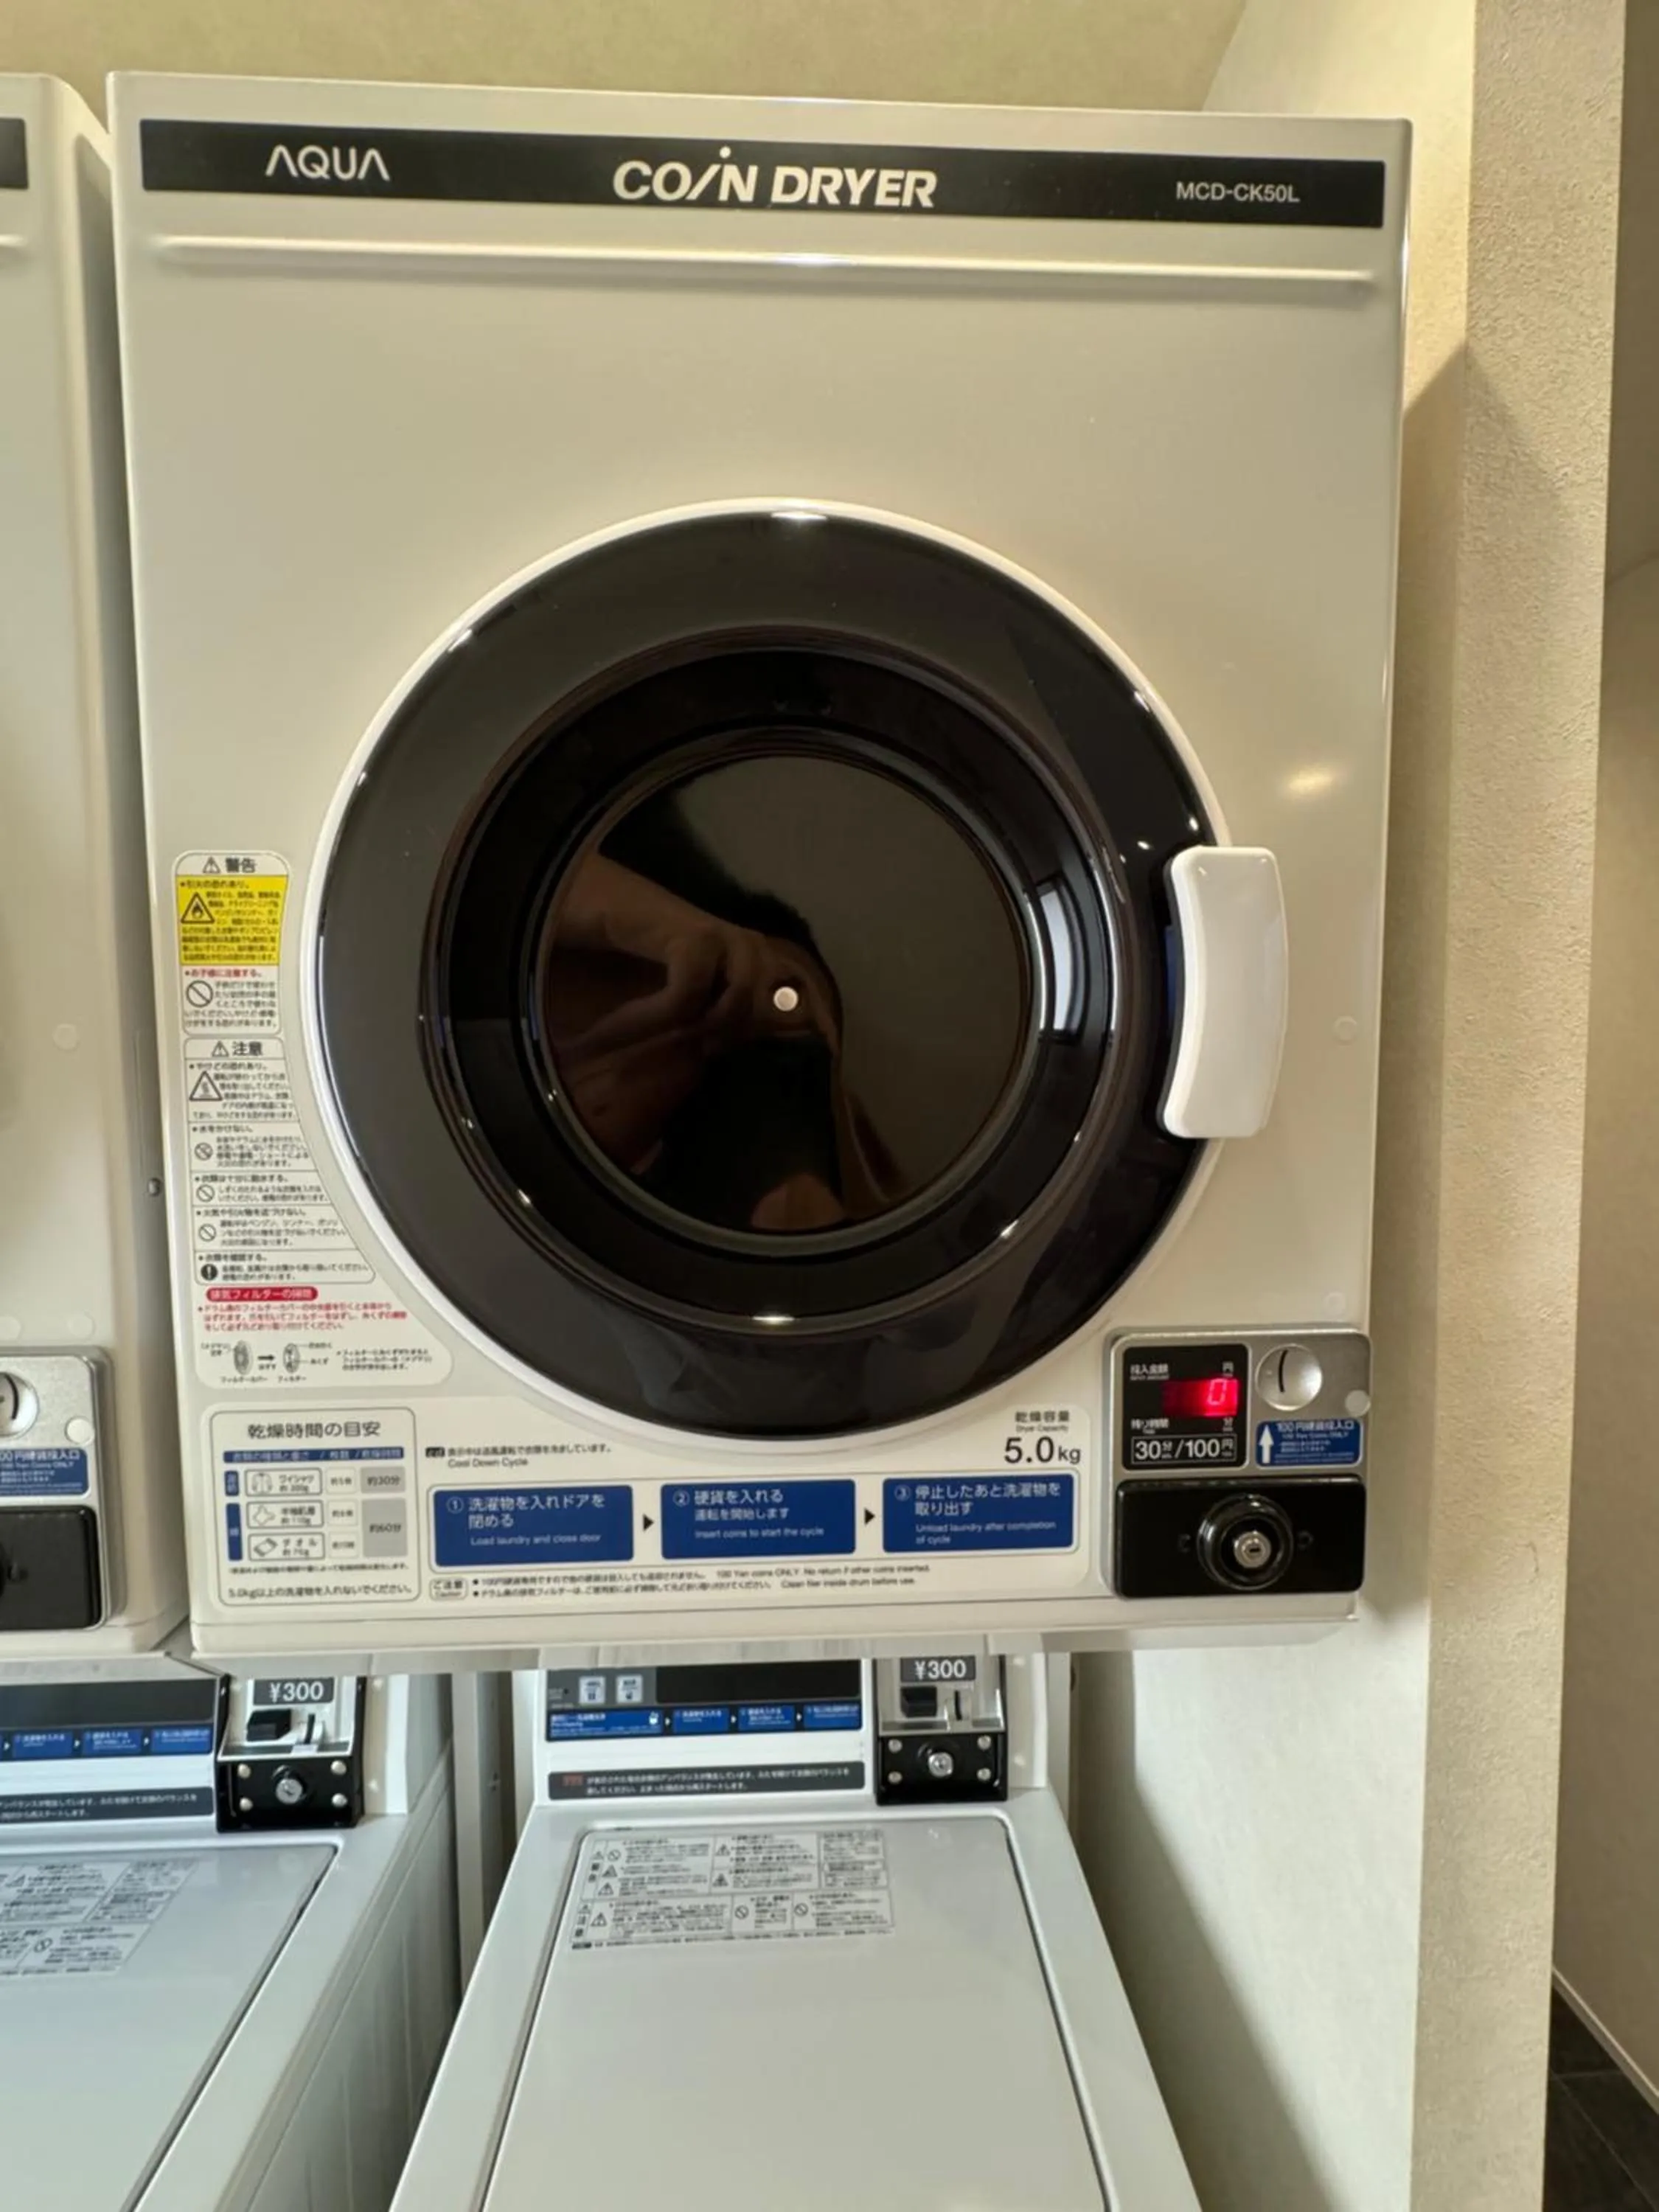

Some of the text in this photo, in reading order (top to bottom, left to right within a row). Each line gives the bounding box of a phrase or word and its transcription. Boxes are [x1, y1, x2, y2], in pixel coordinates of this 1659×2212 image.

[265, 144, 391, 182] AQUA
[771, 165, 938, 208] DRYER
[1175, 181, 1301, 204] MCD-CK50L
[232, 1041, 262, 1057] 注意
[1207, 1377, 1228, 1406] 0
[1015, 1411, 1070, 1423] 乾燥容量
[247, 1420, 381, 1439] 乾燥時間の目安
[694, 1489, 784, 1506] 硬貨を入れる
[914, 1482, 1061, 1500] 停止したあと洗濯物を
[468, 1494, 605, 1512] 洗濯物を入れドアを
[914, 1501, 973, 1517] 取り出す
[468, 1513, 515, 1530] 閉める
[915, 1658, 967, 1680] ¥300
[270, 1680, 324, 1704] ¥300
